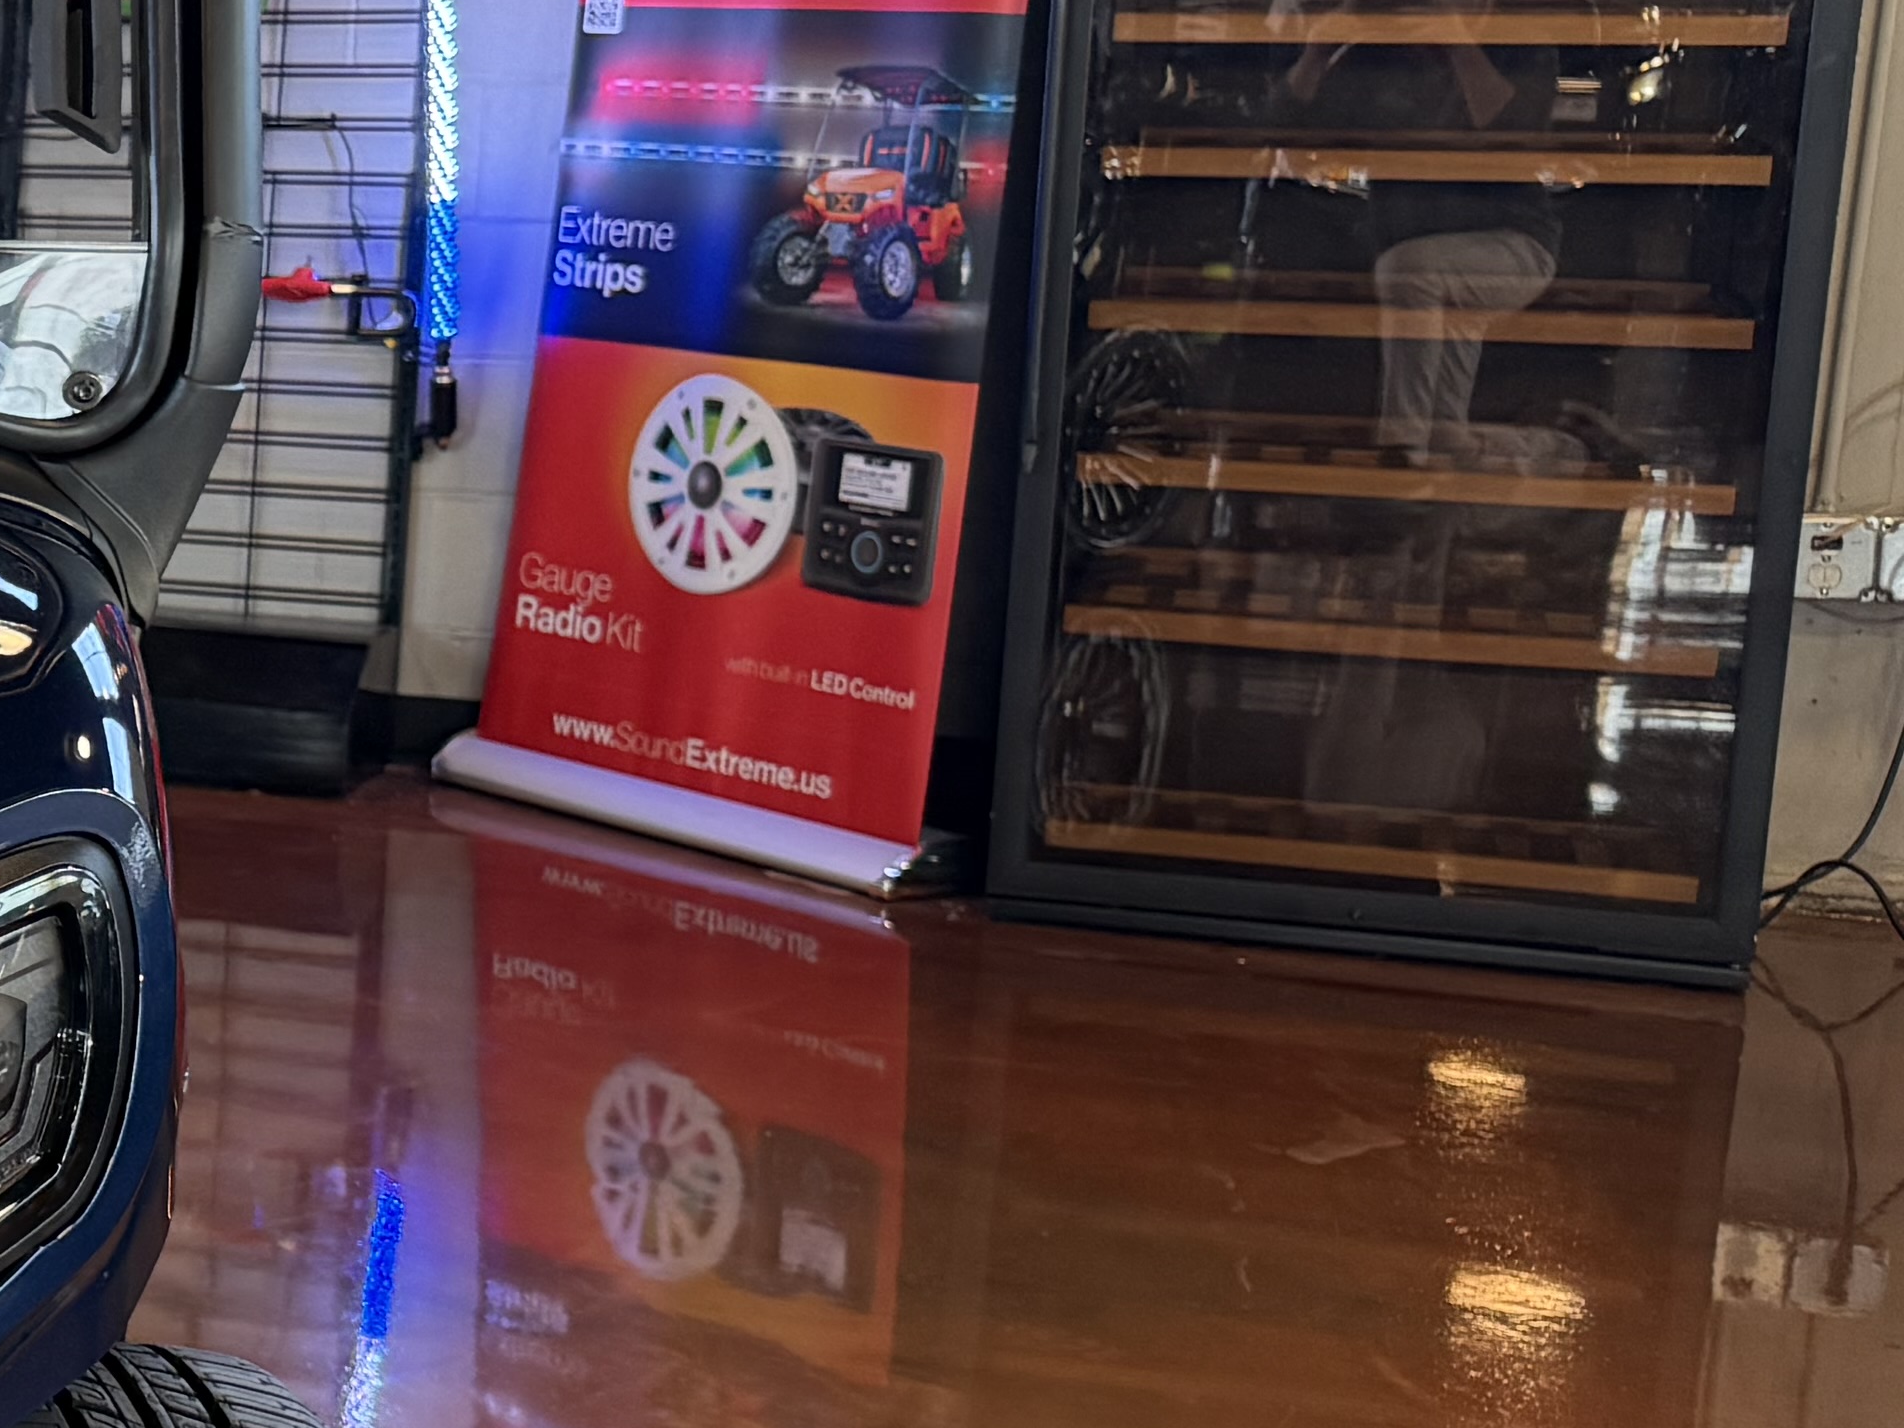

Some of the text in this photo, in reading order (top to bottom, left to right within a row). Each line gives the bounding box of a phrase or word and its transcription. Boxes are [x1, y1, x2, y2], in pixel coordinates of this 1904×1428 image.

[558, 205, 675, 252] Extreme
[552, 248, 646, 299] Strips
[519, 552, 613, 608] Gauge
[515, 592, 643, 654] Radio Kit
[810, 667, 848, 695] LED
[849, 676, 916, 710] Control
[552, 712, 833, 800] www.SoundExtreme.us
